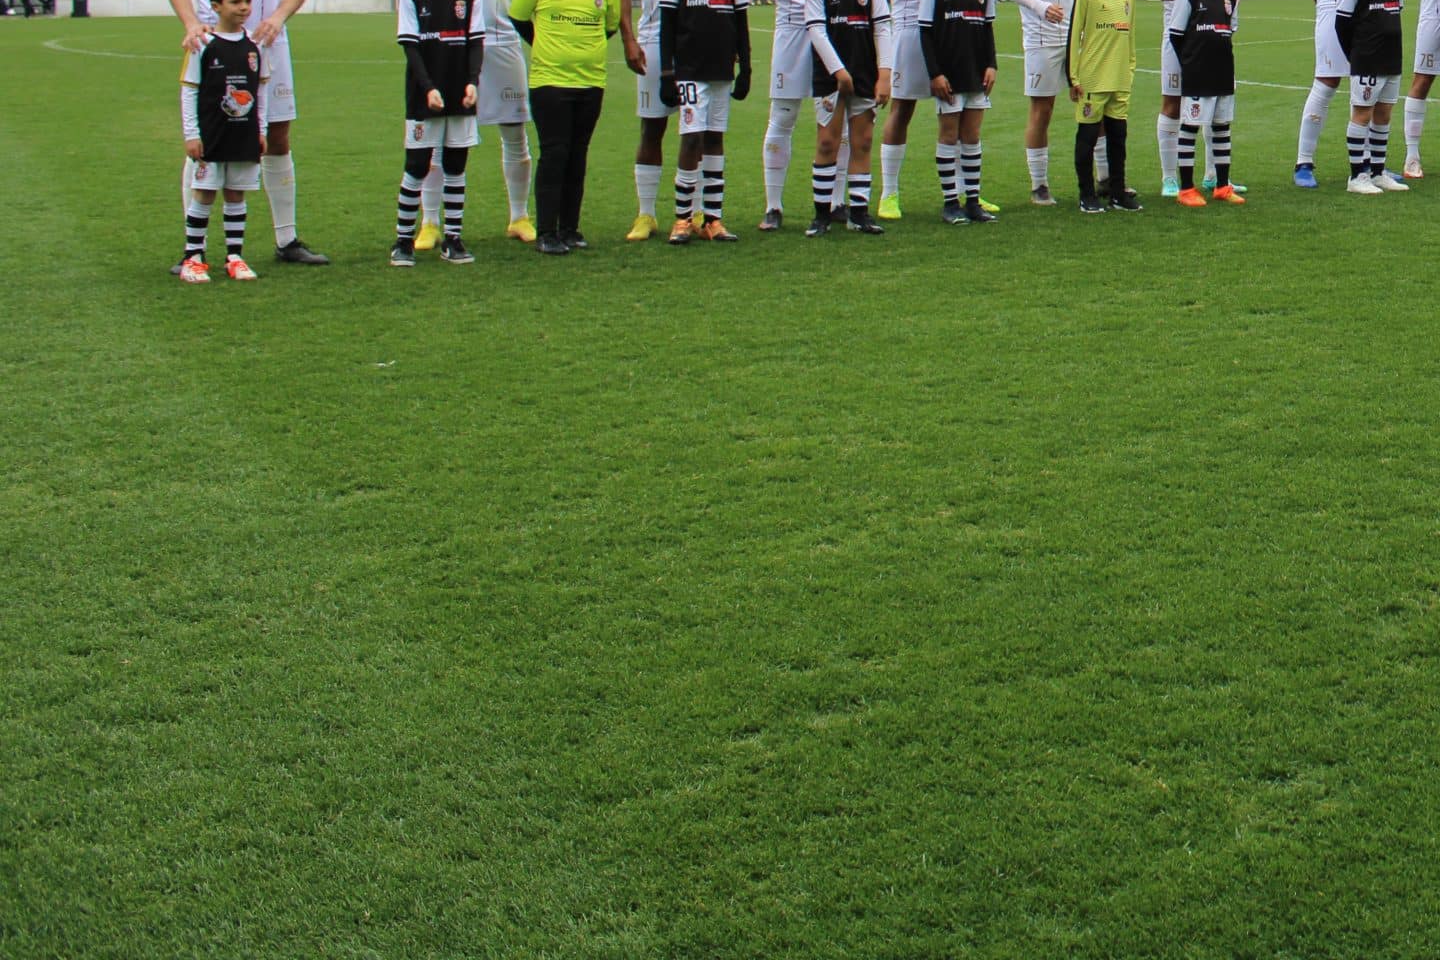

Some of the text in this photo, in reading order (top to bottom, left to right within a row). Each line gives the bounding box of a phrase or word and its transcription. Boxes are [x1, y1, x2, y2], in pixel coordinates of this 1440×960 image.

[1324, 53, 1332, 69] 4
[1420, 52, 1434, 69] 76
[776, 72, 784, 89] 3
[892, 71, 901, 89] 2
[1030, 73, 1042, 89] 17
[1167, 72, 1180, 89] 19
